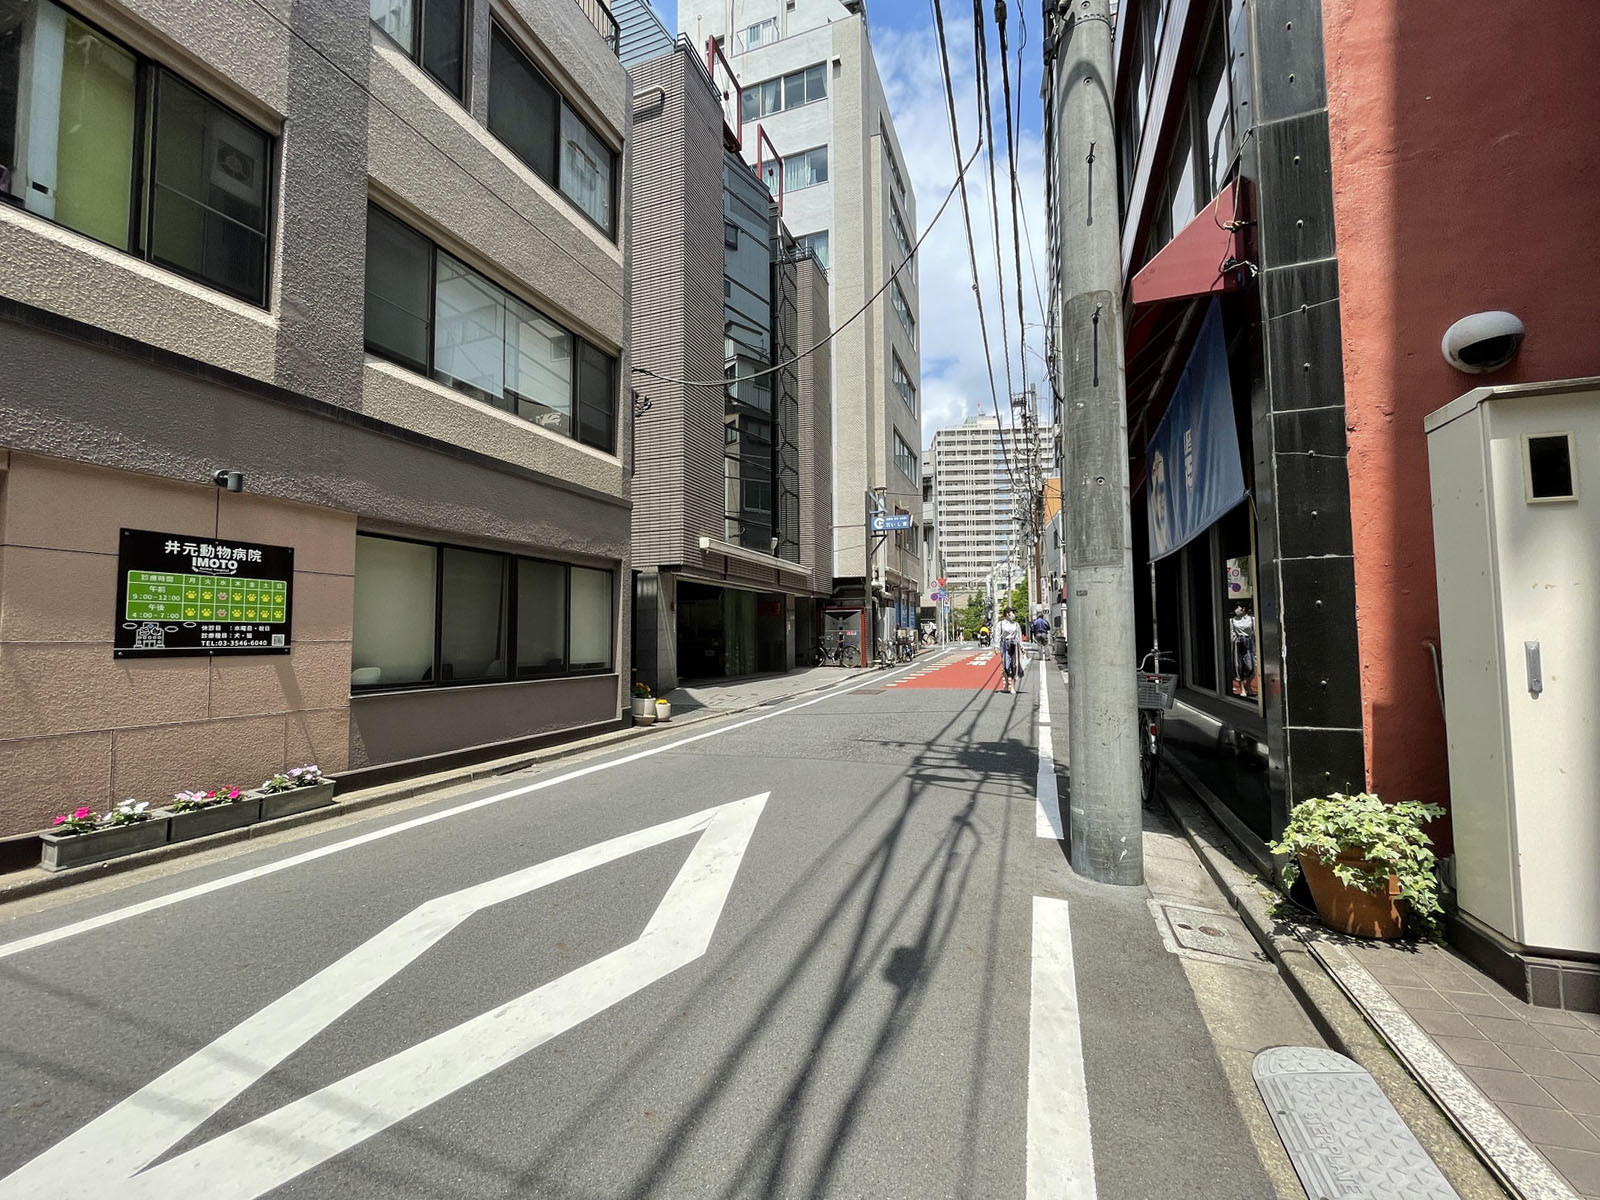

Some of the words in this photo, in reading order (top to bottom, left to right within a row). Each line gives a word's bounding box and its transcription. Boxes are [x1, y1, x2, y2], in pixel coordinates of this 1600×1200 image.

[164, 540, 262, 562] 井元動物病院
[192, 556, 238, 570] IMOTO
